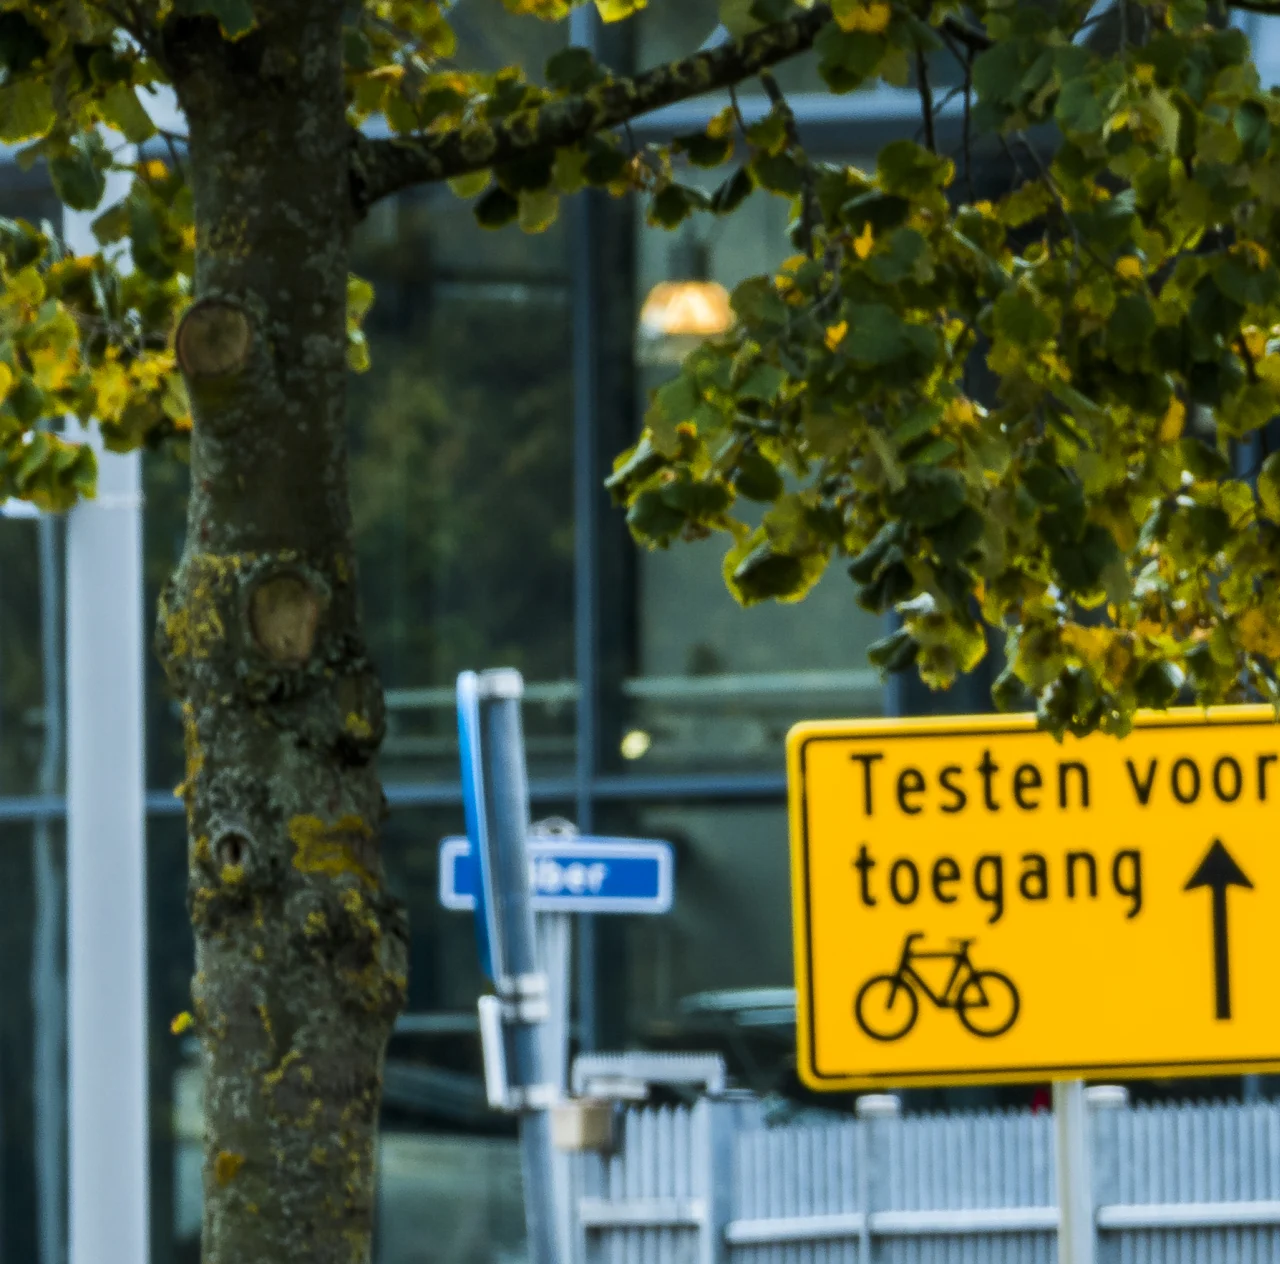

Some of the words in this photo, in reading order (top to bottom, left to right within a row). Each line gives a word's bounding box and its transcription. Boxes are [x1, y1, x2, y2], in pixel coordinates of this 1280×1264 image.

[850, 750, 1091, 817] Testen
[1125, 753, 1279, 806] voor
[853, 845, 1144, 924] toegang
